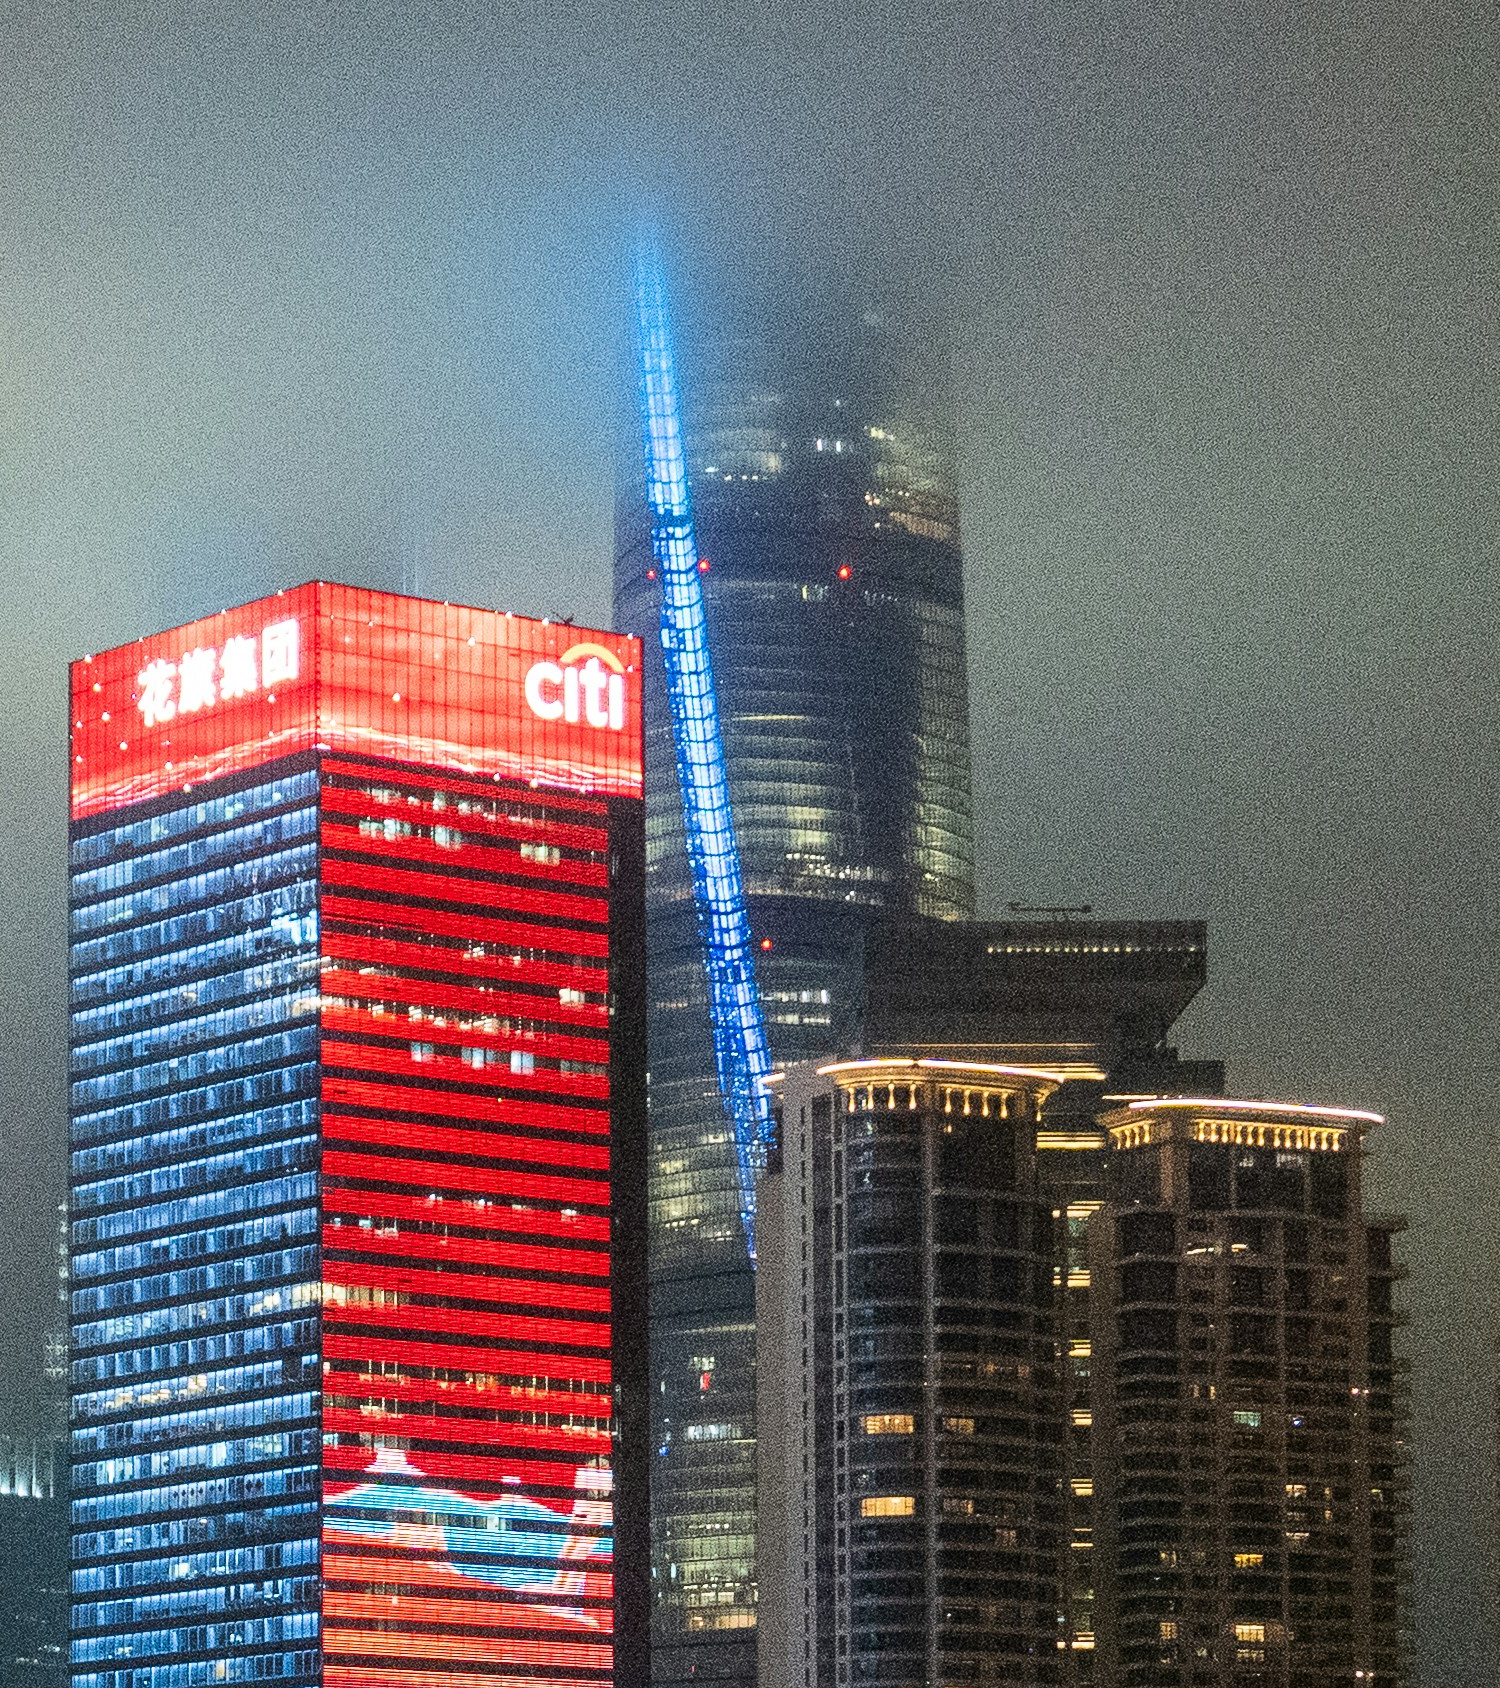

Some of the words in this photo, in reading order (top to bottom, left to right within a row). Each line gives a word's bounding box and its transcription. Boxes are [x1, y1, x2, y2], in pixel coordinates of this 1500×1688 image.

[137, 618, 299, 728] 花旗集团
[524, 653, 624, 731] citi
